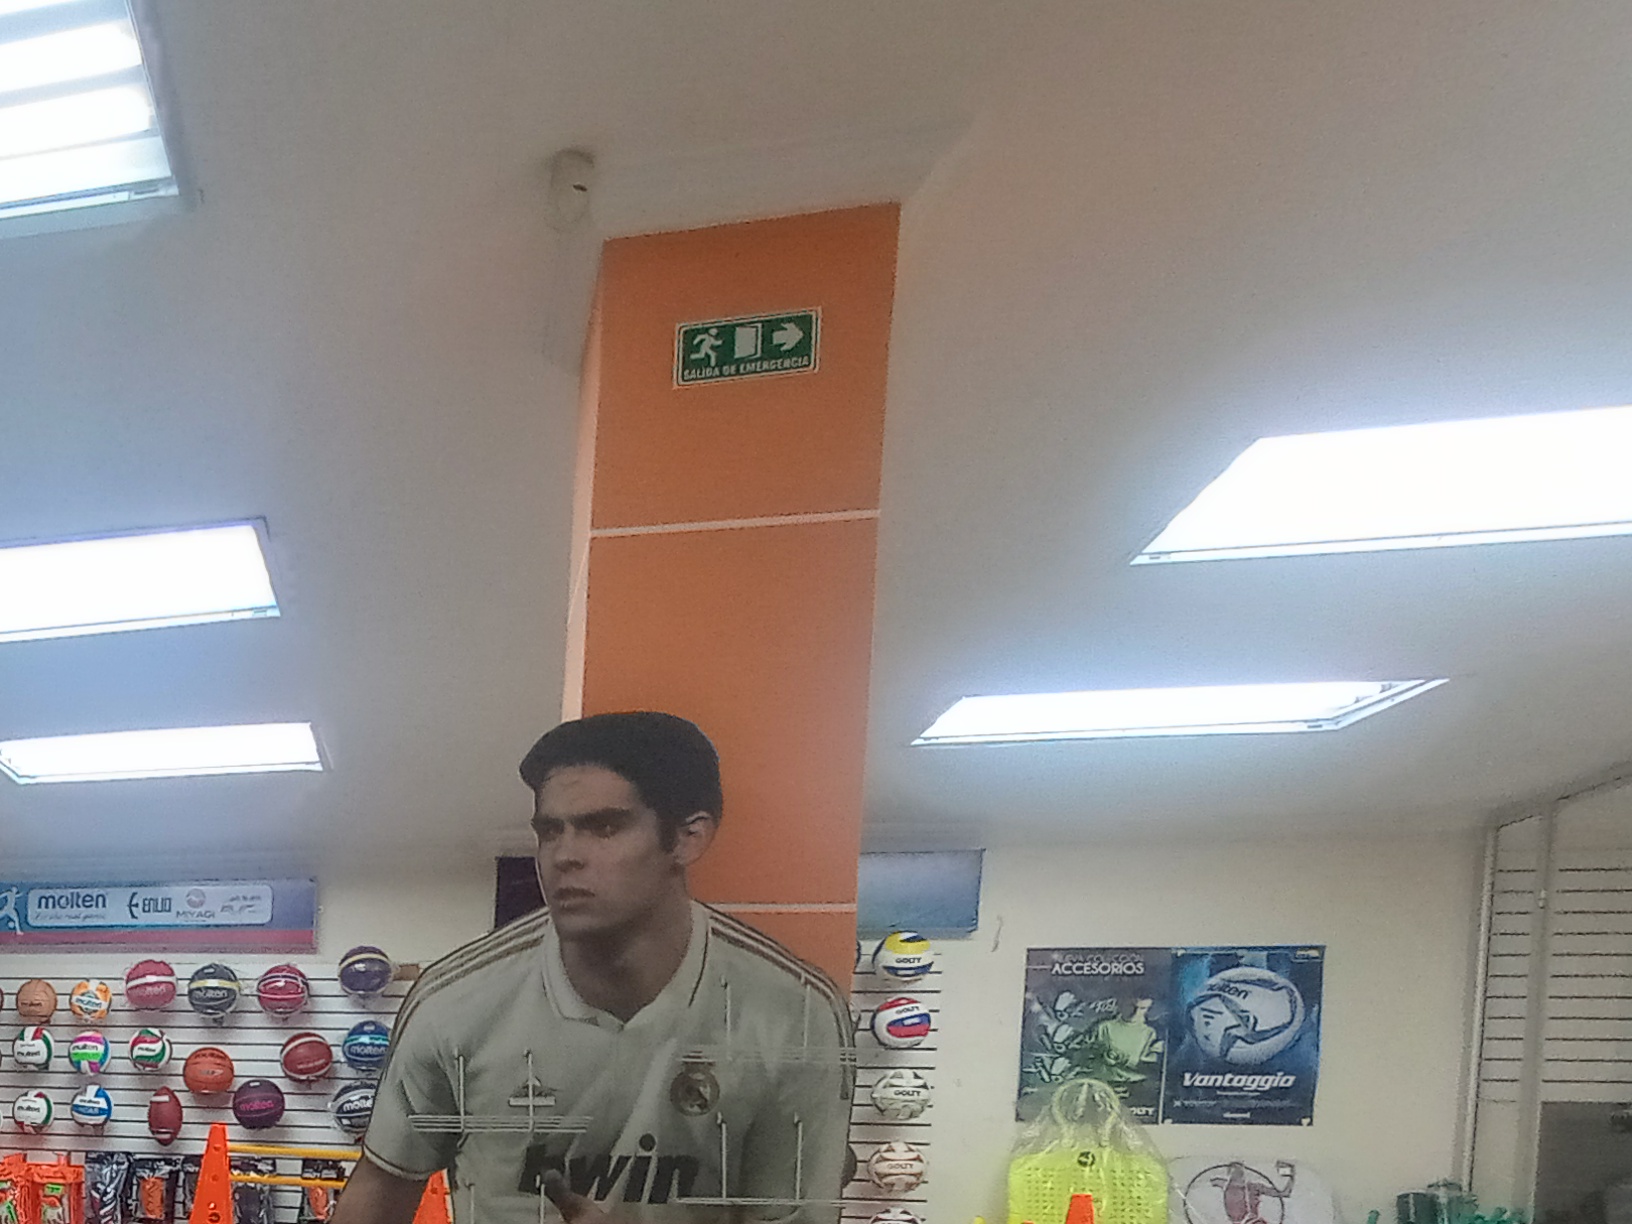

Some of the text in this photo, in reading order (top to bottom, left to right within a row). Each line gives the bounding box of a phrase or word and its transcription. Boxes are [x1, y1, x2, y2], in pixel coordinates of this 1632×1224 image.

[684, 355, 810, 381] SALIDA DE EMERGENCIA
[36, 891, 107, 910] molten
[1051, 962, 1145, 975] ACCESORIOS
[194, 989, 228, 1000] molten
[895, 1005, 920, 1015] GOLTY
[1183, 1072, 1297, 1090] Vantaggio
[893, 1089, 922, 1097] GOLTY
